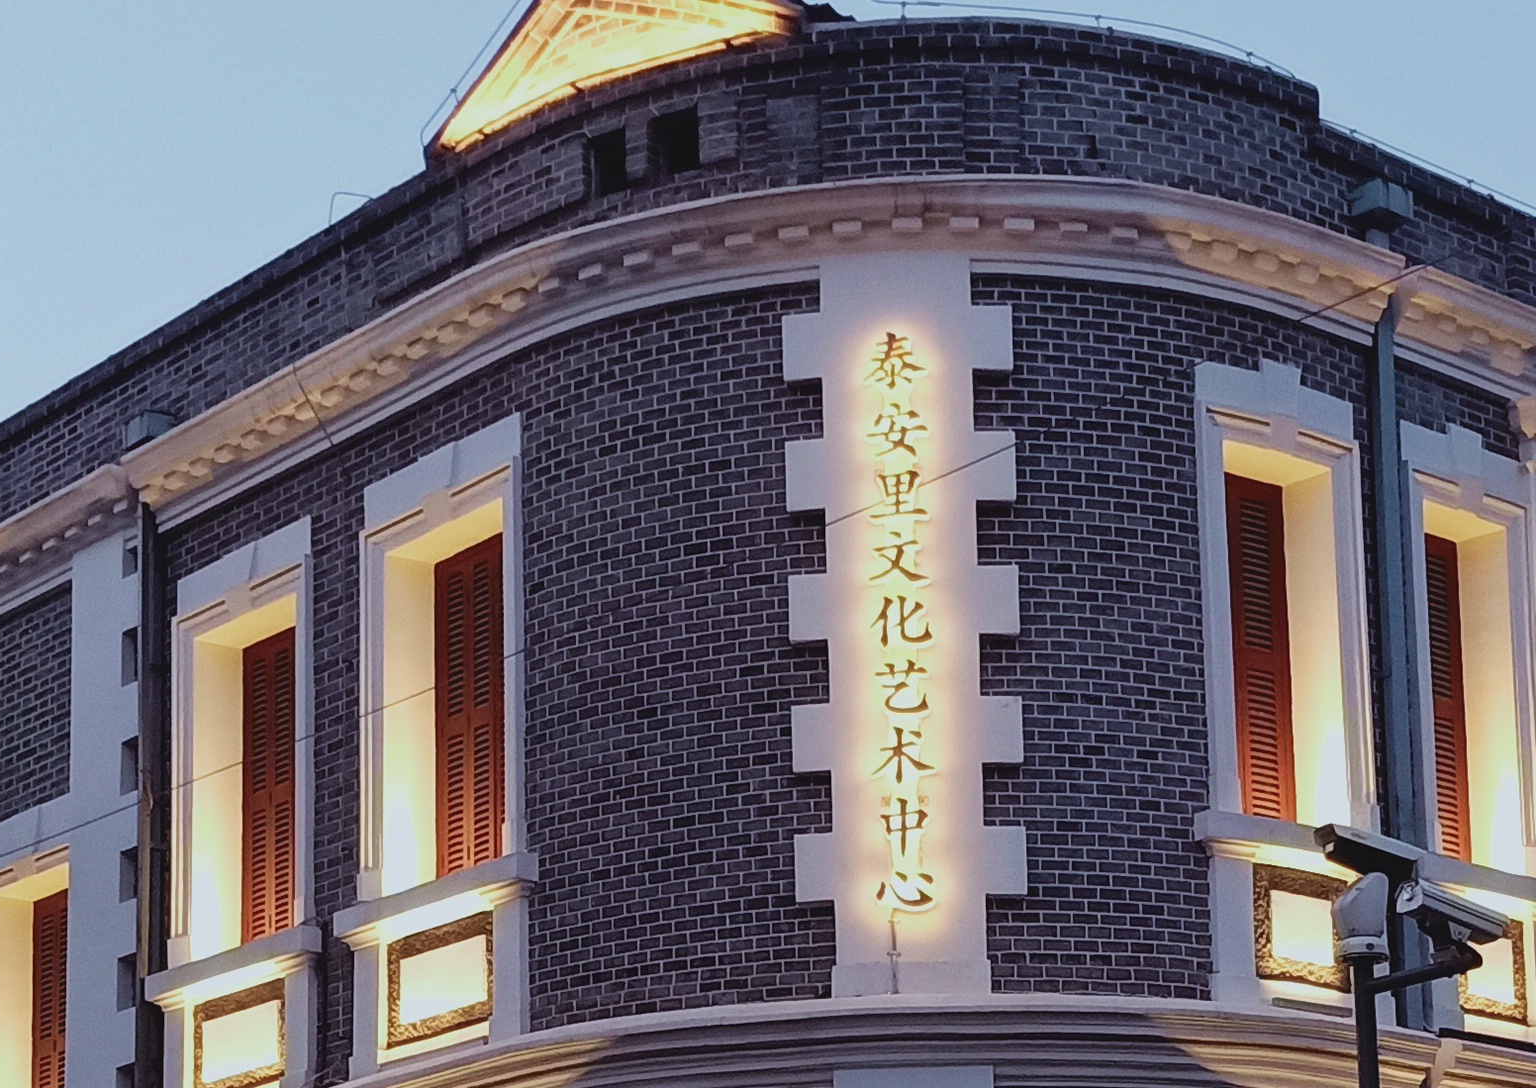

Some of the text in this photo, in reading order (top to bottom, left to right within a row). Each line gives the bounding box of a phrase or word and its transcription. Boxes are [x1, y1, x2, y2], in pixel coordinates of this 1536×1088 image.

[863, 331, 936, 907] 泰安里文化艺术中心
